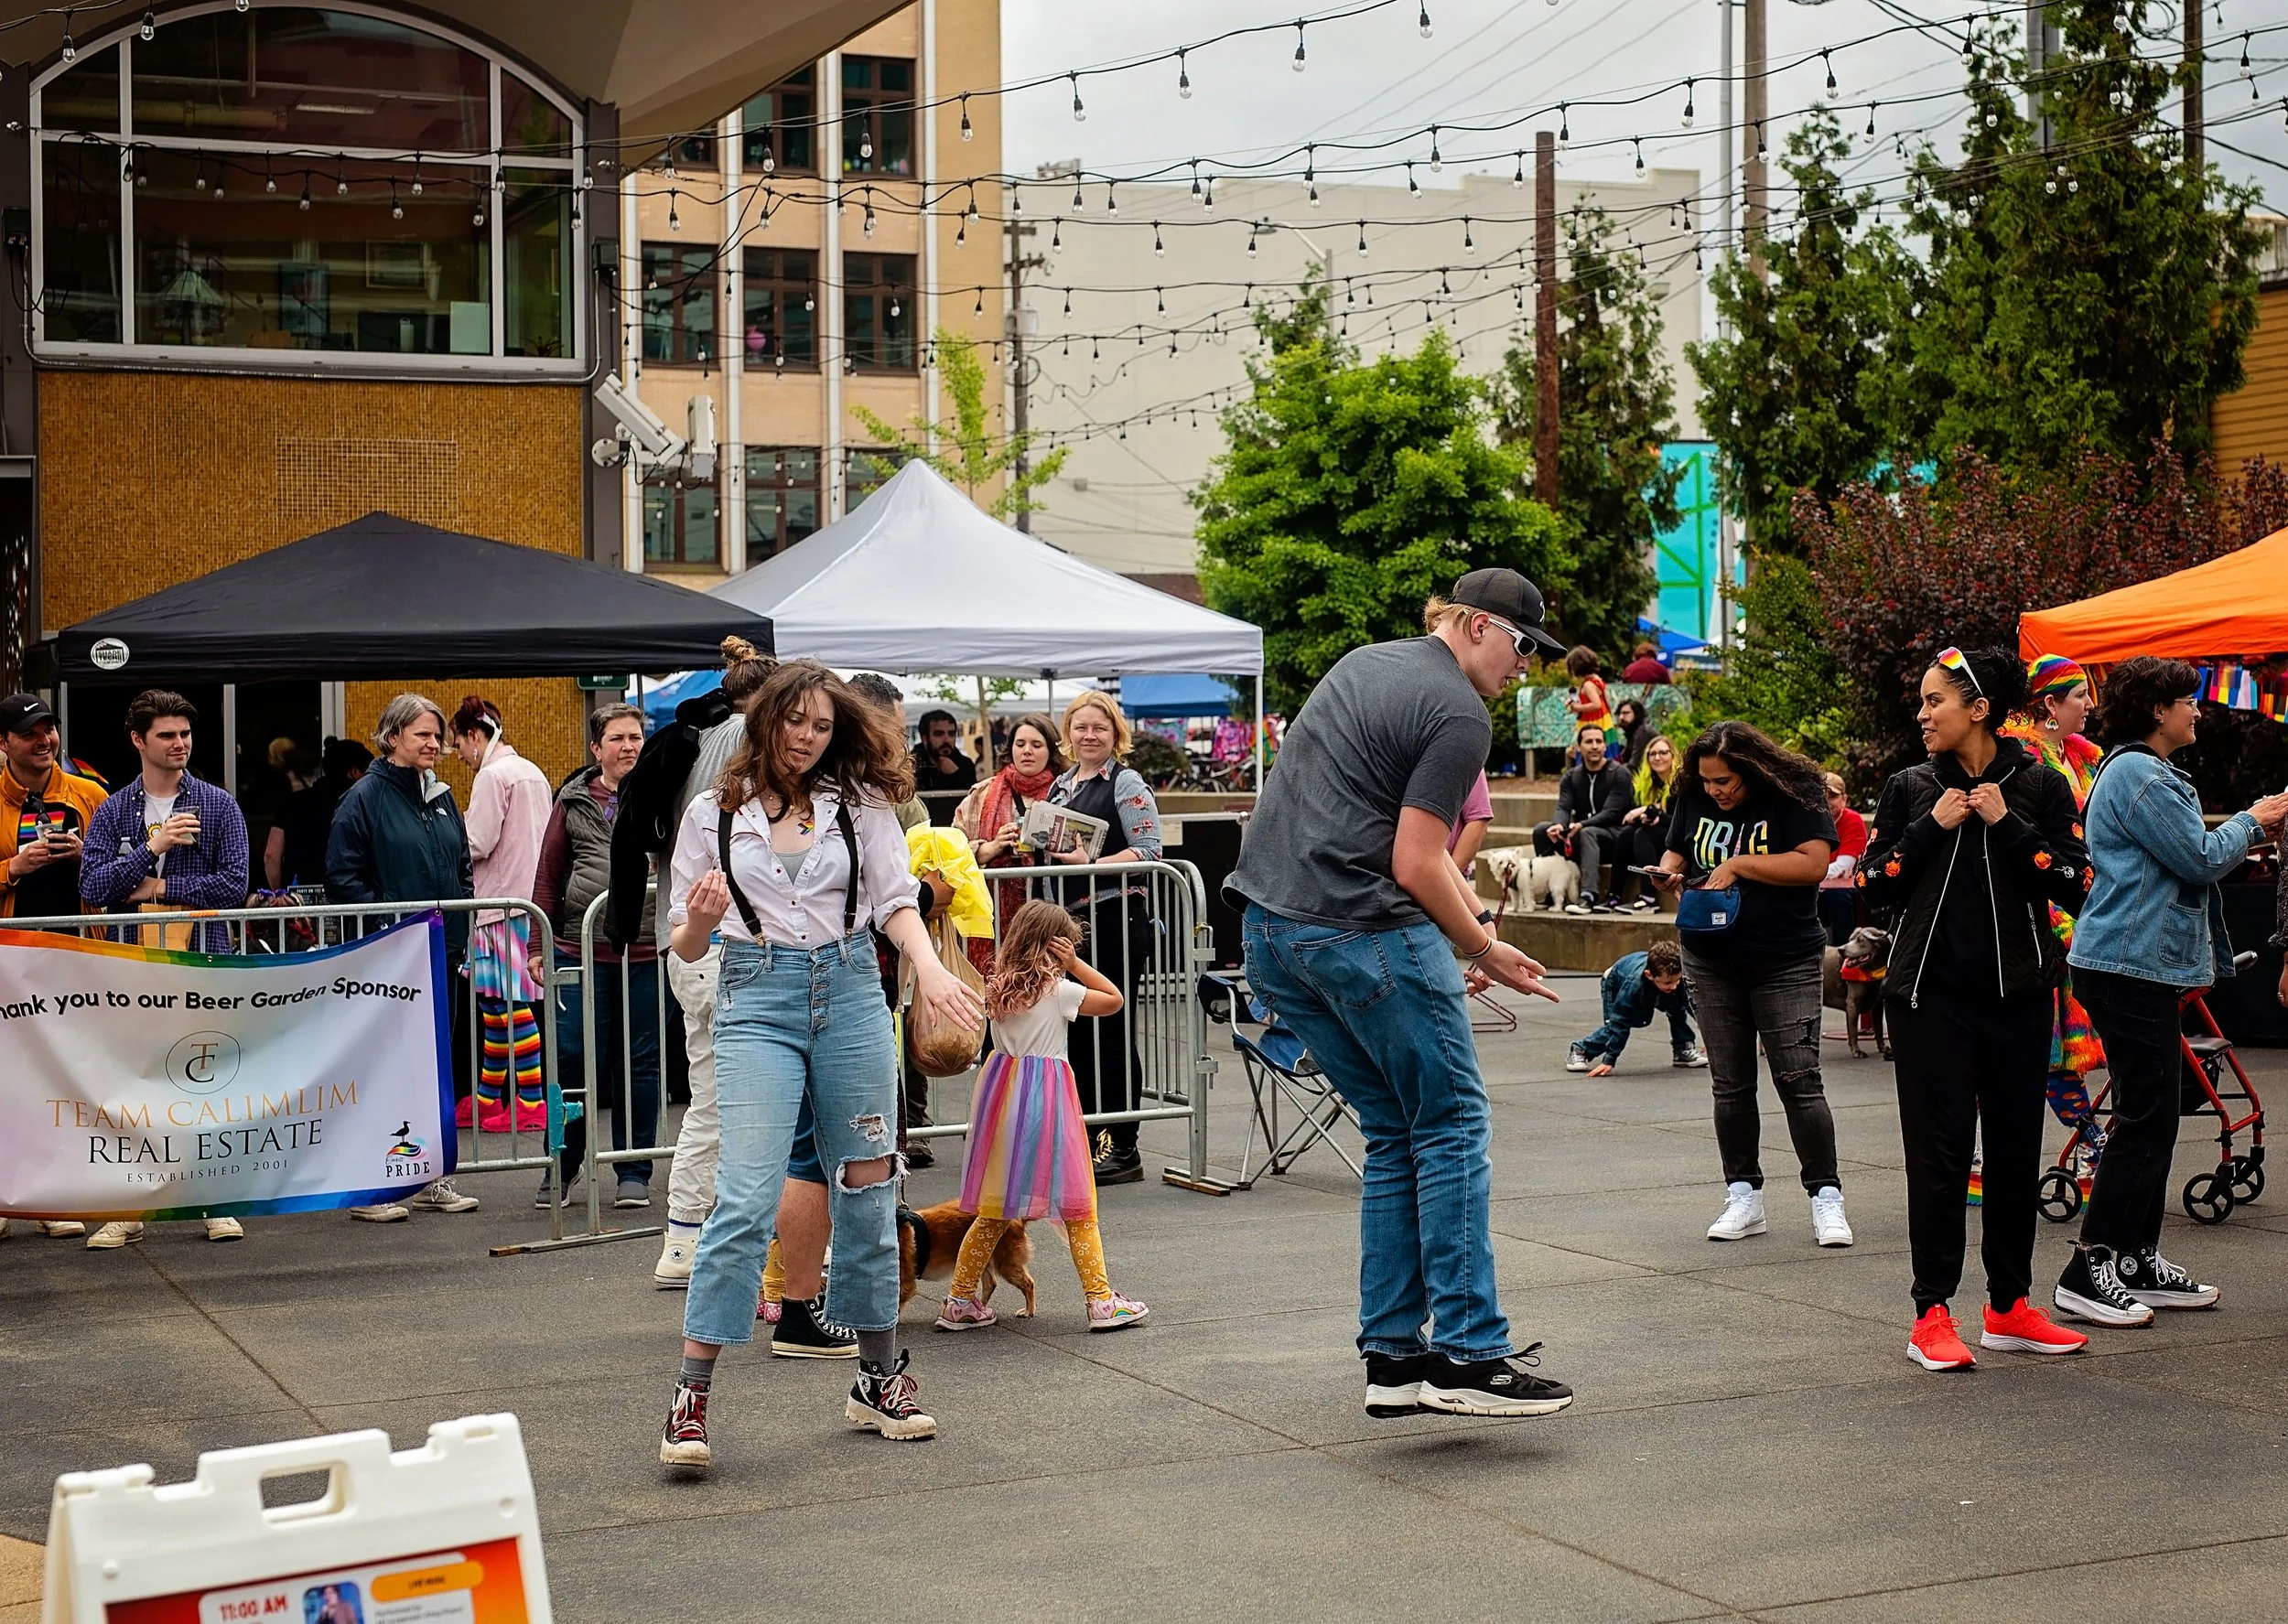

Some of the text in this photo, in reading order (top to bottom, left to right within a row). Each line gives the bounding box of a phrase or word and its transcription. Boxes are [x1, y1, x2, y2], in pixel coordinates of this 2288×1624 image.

[54, 993, 100, 1015] you
[106, 991, 130, 1006] to
[137, 995, 178, 1008] our
[186, 991, 243, 1009] Beer
[251, 985, 327, 1008] Garden
[331, 977, 421, 1001] Sponsor
[46, 1080, 358, 1129] TEAM CALIMLIM
[88, 1119, 322, 1164] REAL ESTATE
[127, 1159, 287, 1183] ESTABLISHED 2001
[386, 1161, 430, 1178] PRIDE
[220, 1594, 288, 1622] 11:00 AM
